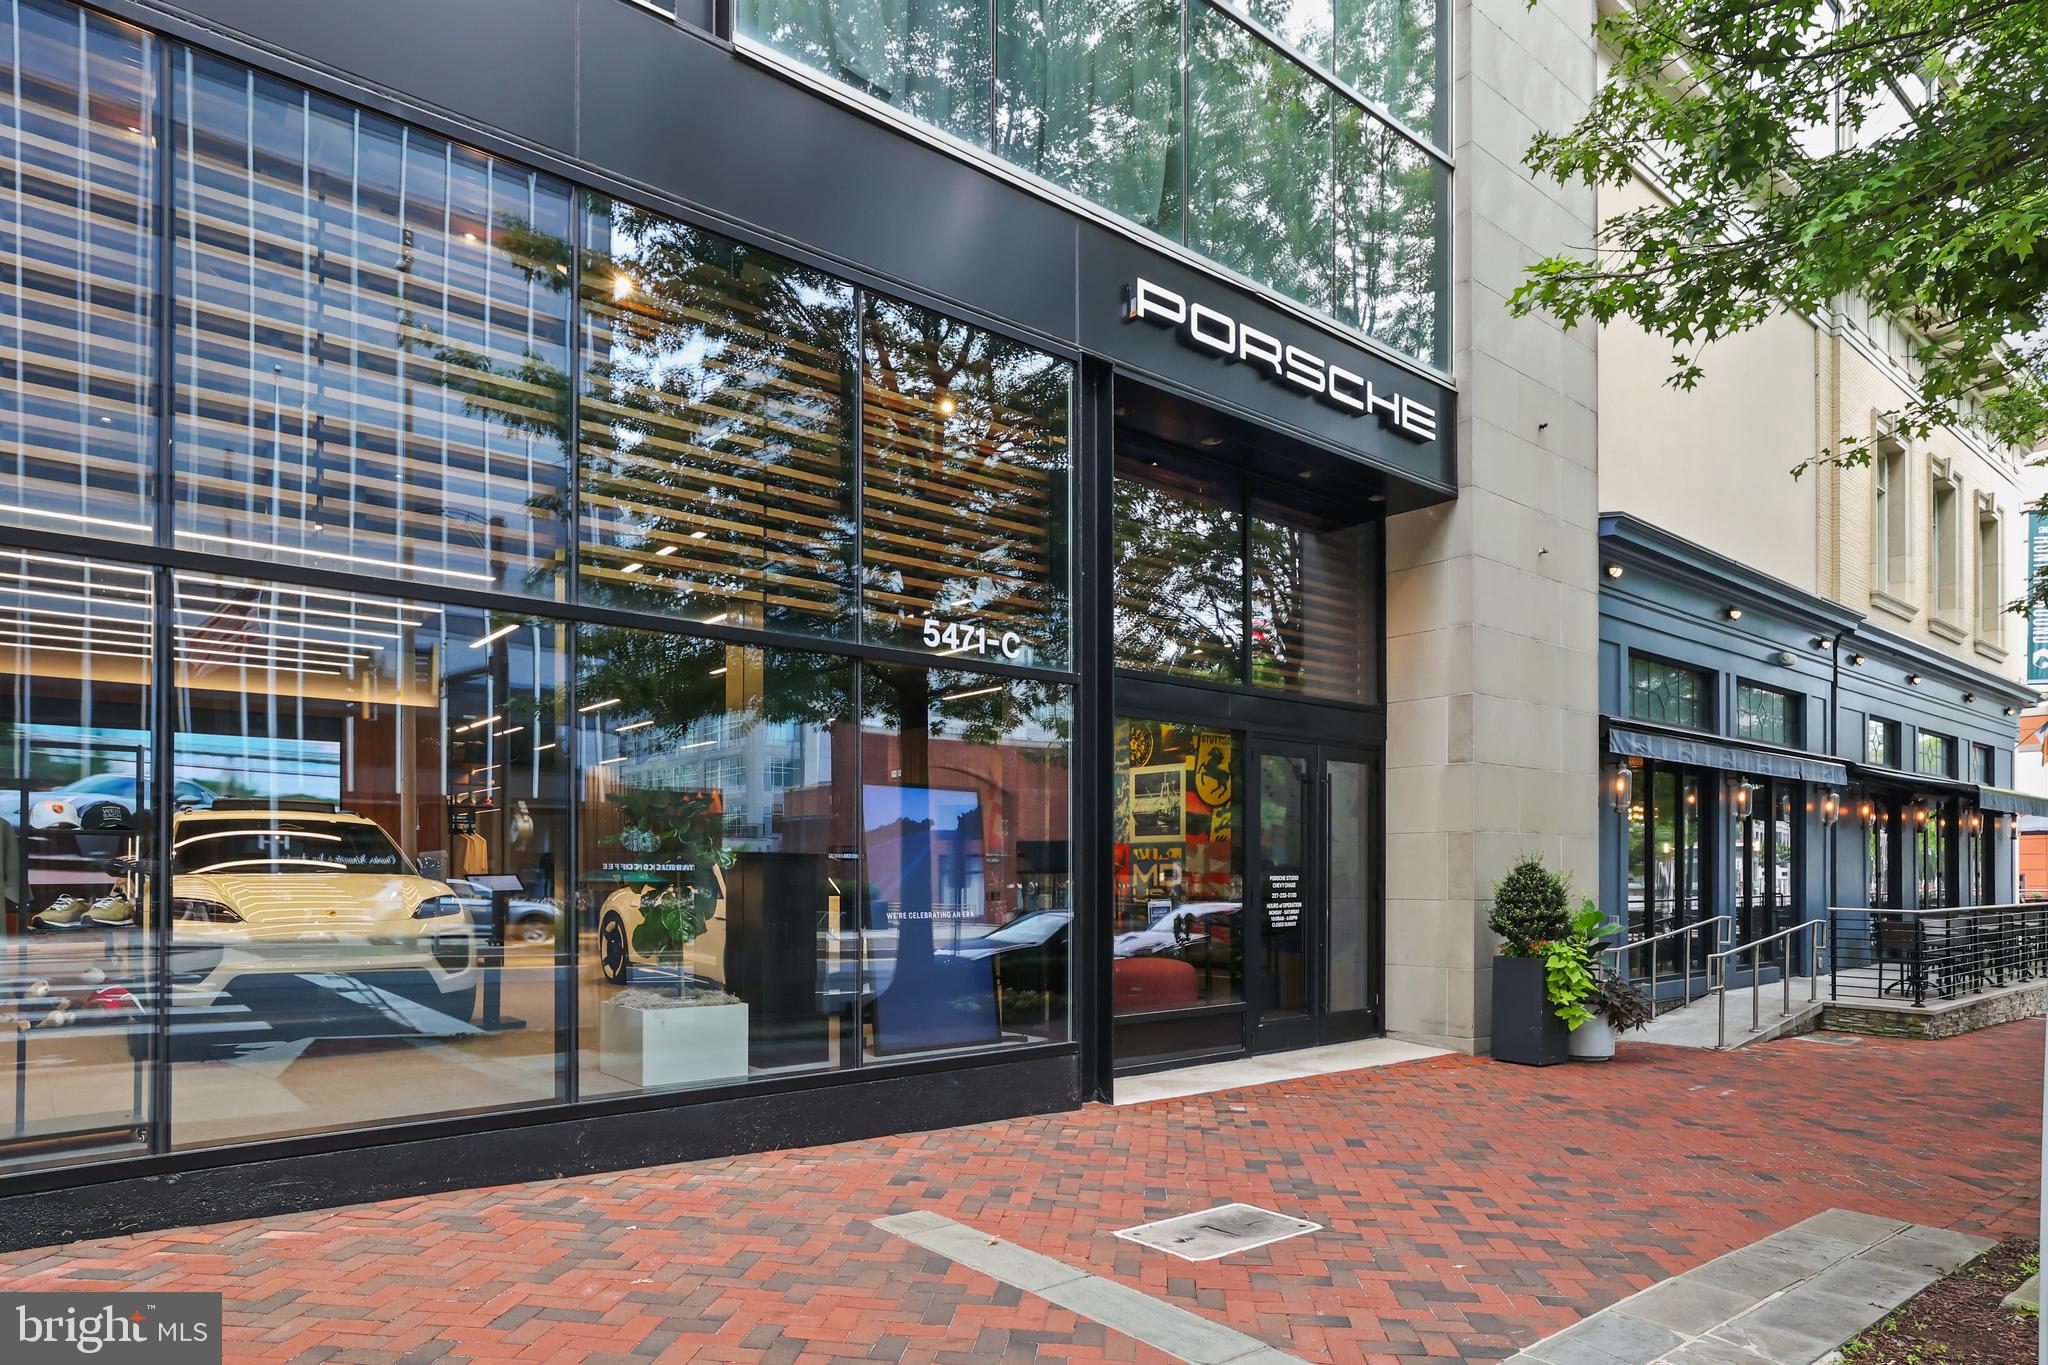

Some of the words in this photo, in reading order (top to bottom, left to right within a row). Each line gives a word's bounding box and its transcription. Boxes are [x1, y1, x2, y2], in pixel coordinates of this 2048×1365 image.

[1135, 277, 1436, 441] PORSCHE
[923, 619, 1020, 659] 5471-C
[908, 911, 951, 919] CELEBRATING
